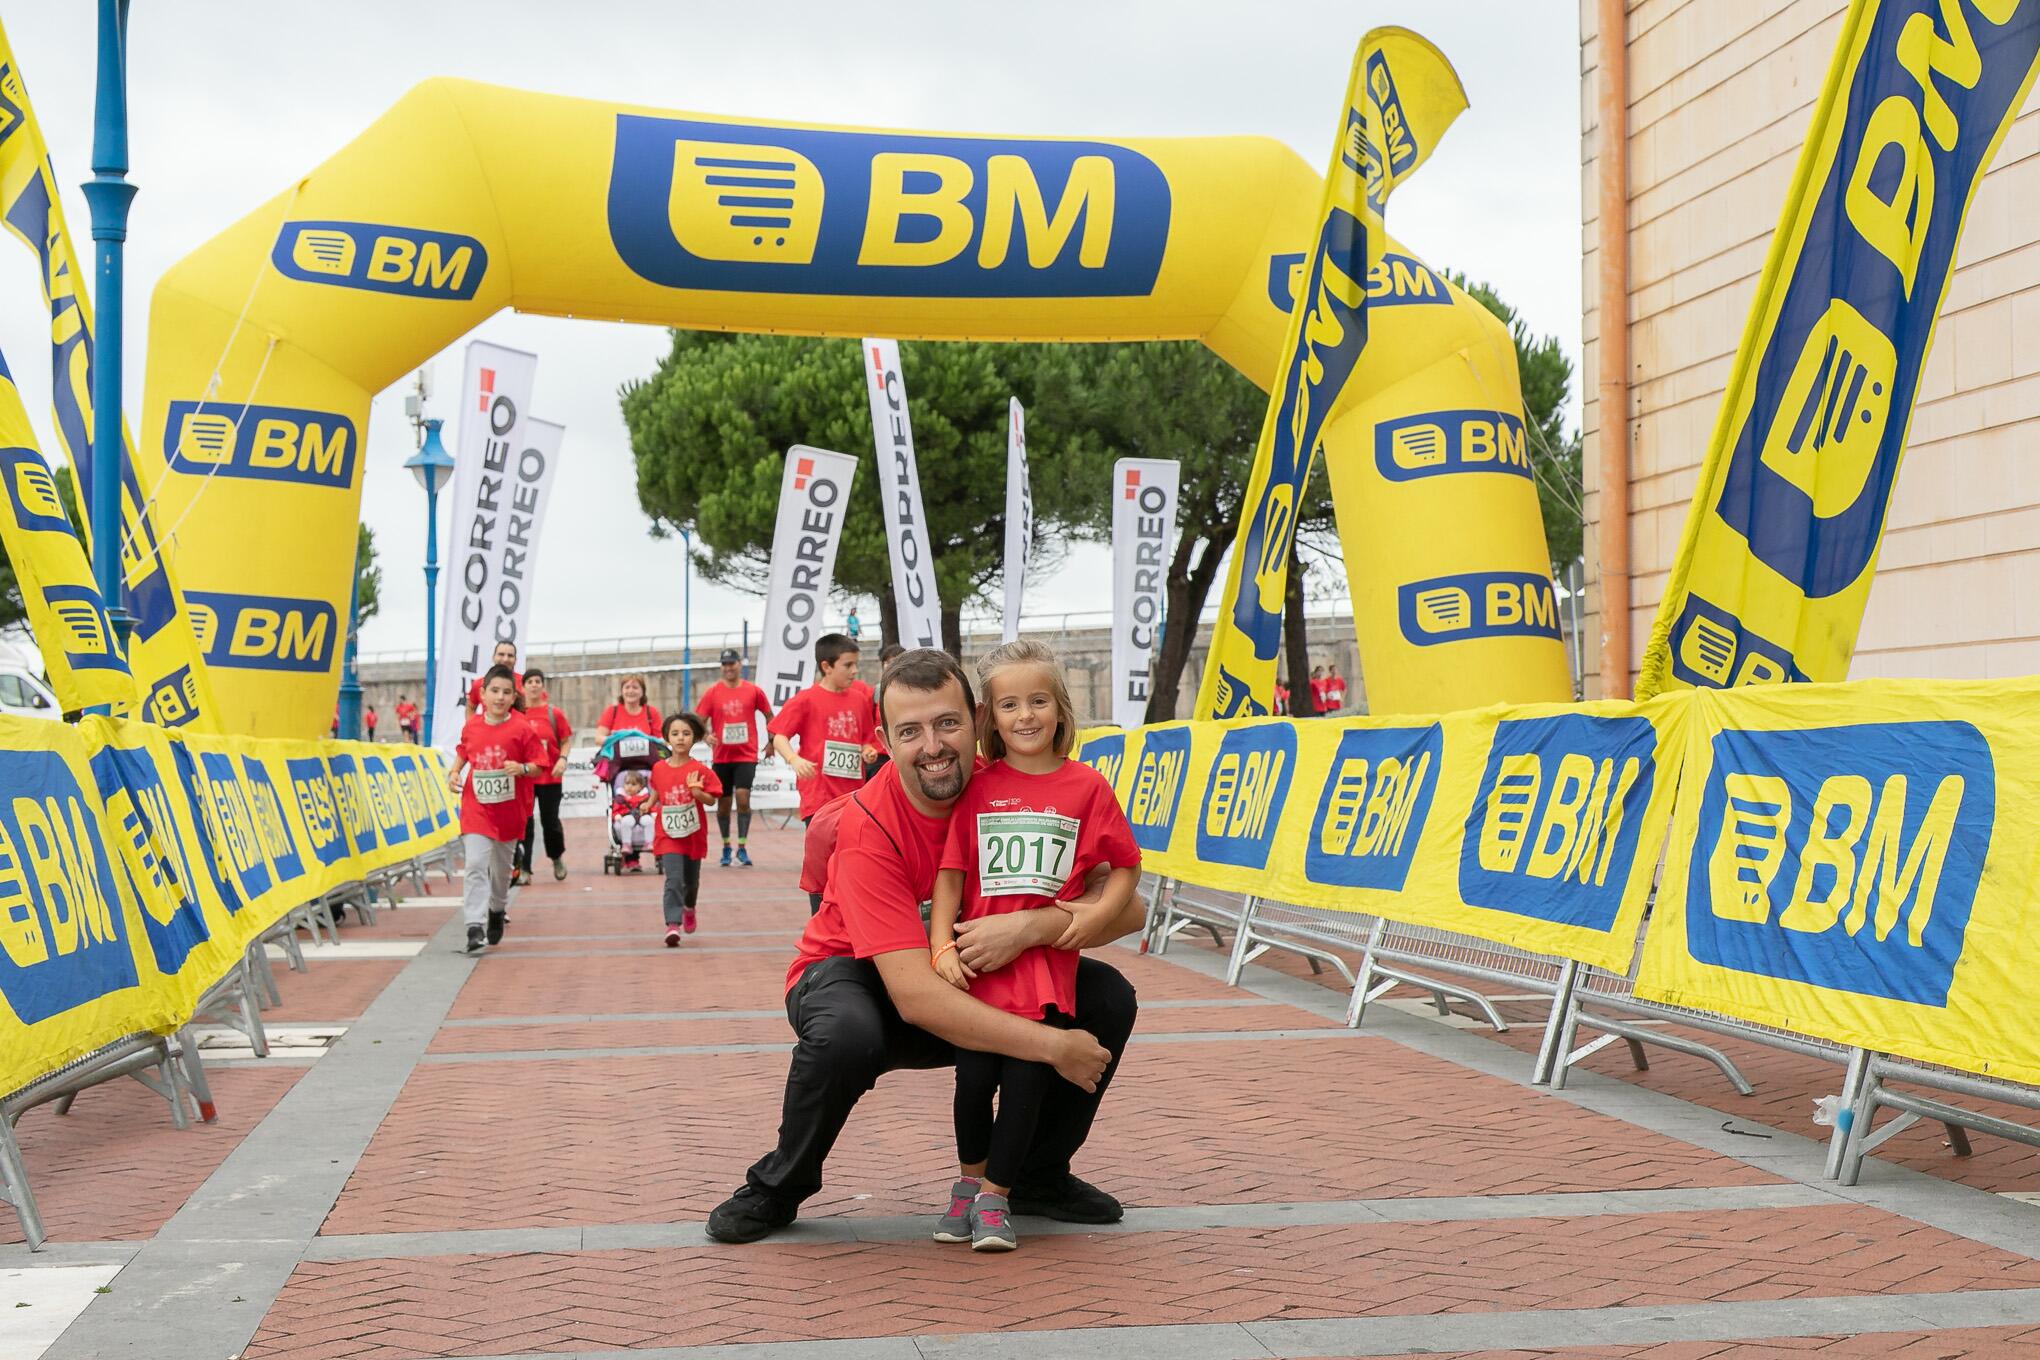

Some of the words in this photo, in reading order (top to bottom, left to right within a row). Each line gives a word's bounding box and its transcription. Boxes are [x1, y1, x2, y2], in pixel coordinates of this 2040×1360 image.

[1383, 103, 1412, 165] BM
[857, 152, 1115, 269] BM
[366, 236, 473, 291] BM
[248, 418, 348, 476] BM
[1461, 420, 1528, 469] BM
[461, 395, 516, 632] CORREO
[494, 447, 546, 645] CORREO
[782, 478, 838, 650] CORREO
[1131, 486, 1166, 650] CORREO
[229, 607, 328, 661] BM
[1485, 582, 1556, 630] BM
[774, 660, 805, 706] EL
[476, 778, 510, 796] 2034
[828, 751, 861, 770] 2033
[562, 790, 597, 799] ORREO
[665, 813, 696, 830] 2034
[1228, 750, 1286, 840] BM
[1351, 751, 1431, 857] BM
[1526, 753, 1640, 887] BM
[13, 796, 117, 956] BM
[987, 835, 1067, 876] 2017
[1778, 774, 1966, 948] BM
